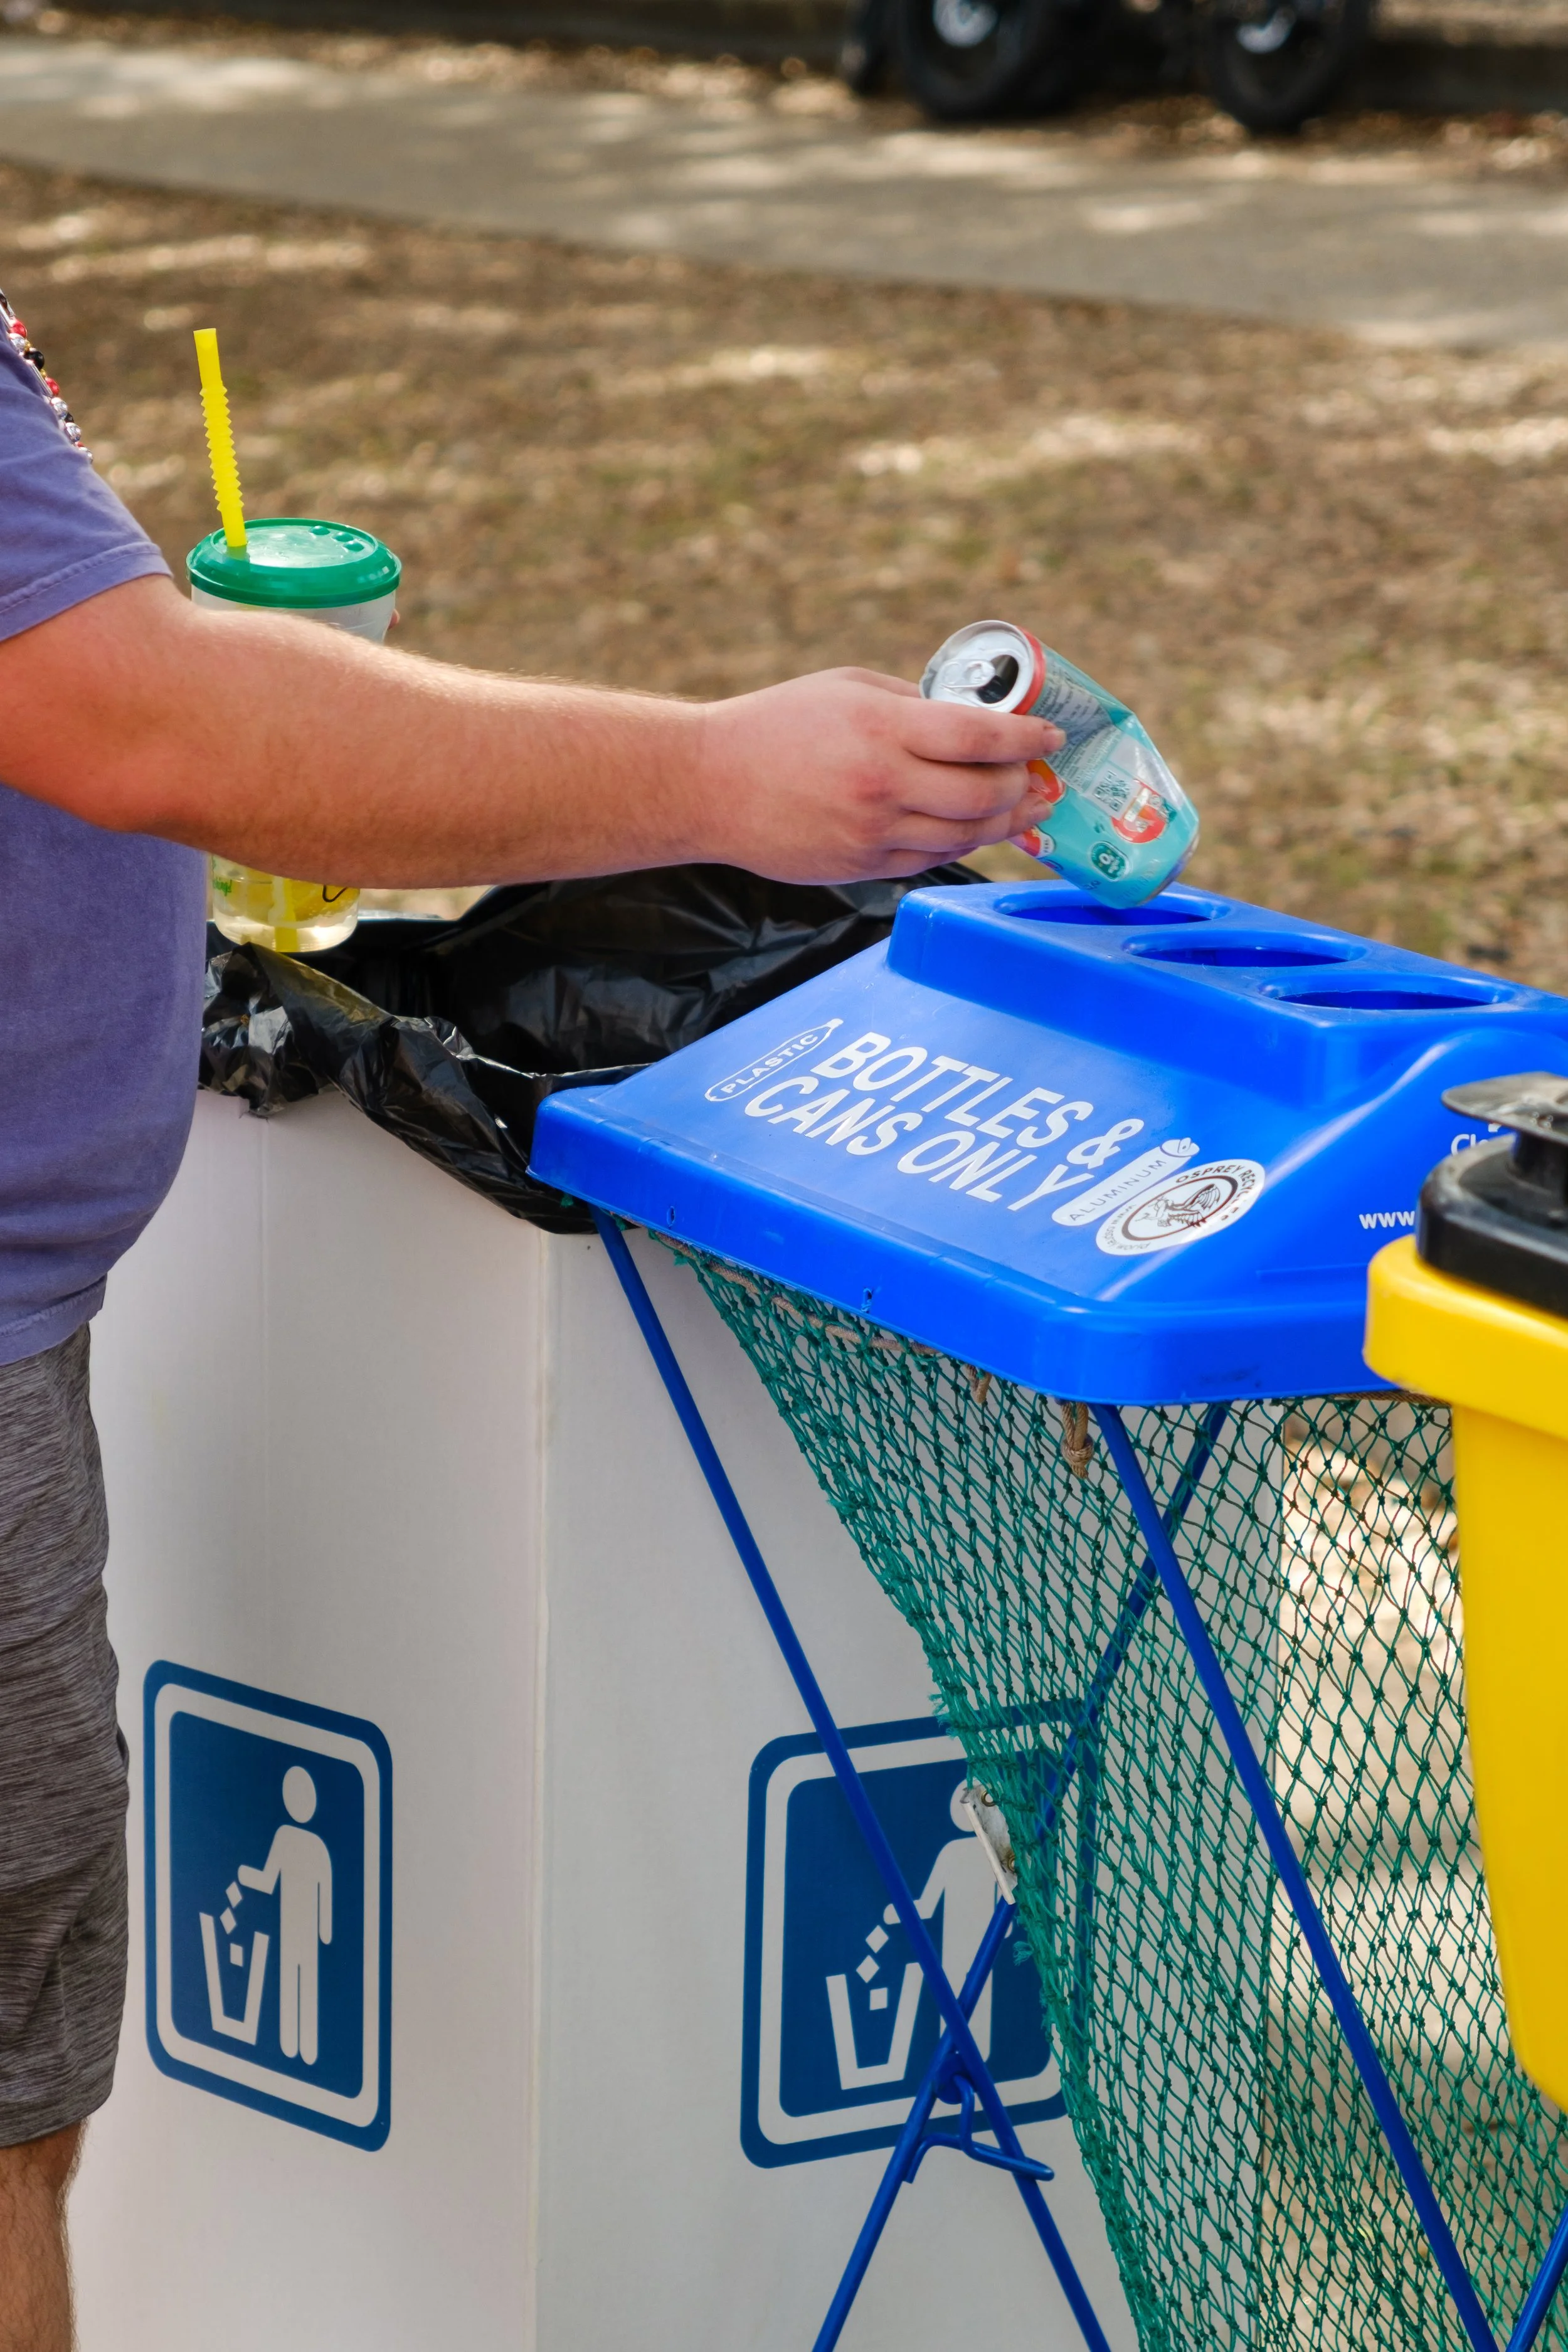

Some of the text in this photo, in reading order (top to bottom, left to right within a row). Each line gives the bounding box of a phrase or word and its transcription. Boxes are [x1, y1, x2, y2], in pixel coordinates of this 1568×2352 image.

[721, 1034, 818, 1094] PLASTIC
[810, 1031, 1144, 1170] BOTTLES &
[744, 1076, 1094, 1211] CANS ONLY
[1175, 1164, 1242, 1184] OSPREY
[1069, 1159, 1167, 1222] ALUMINUM
